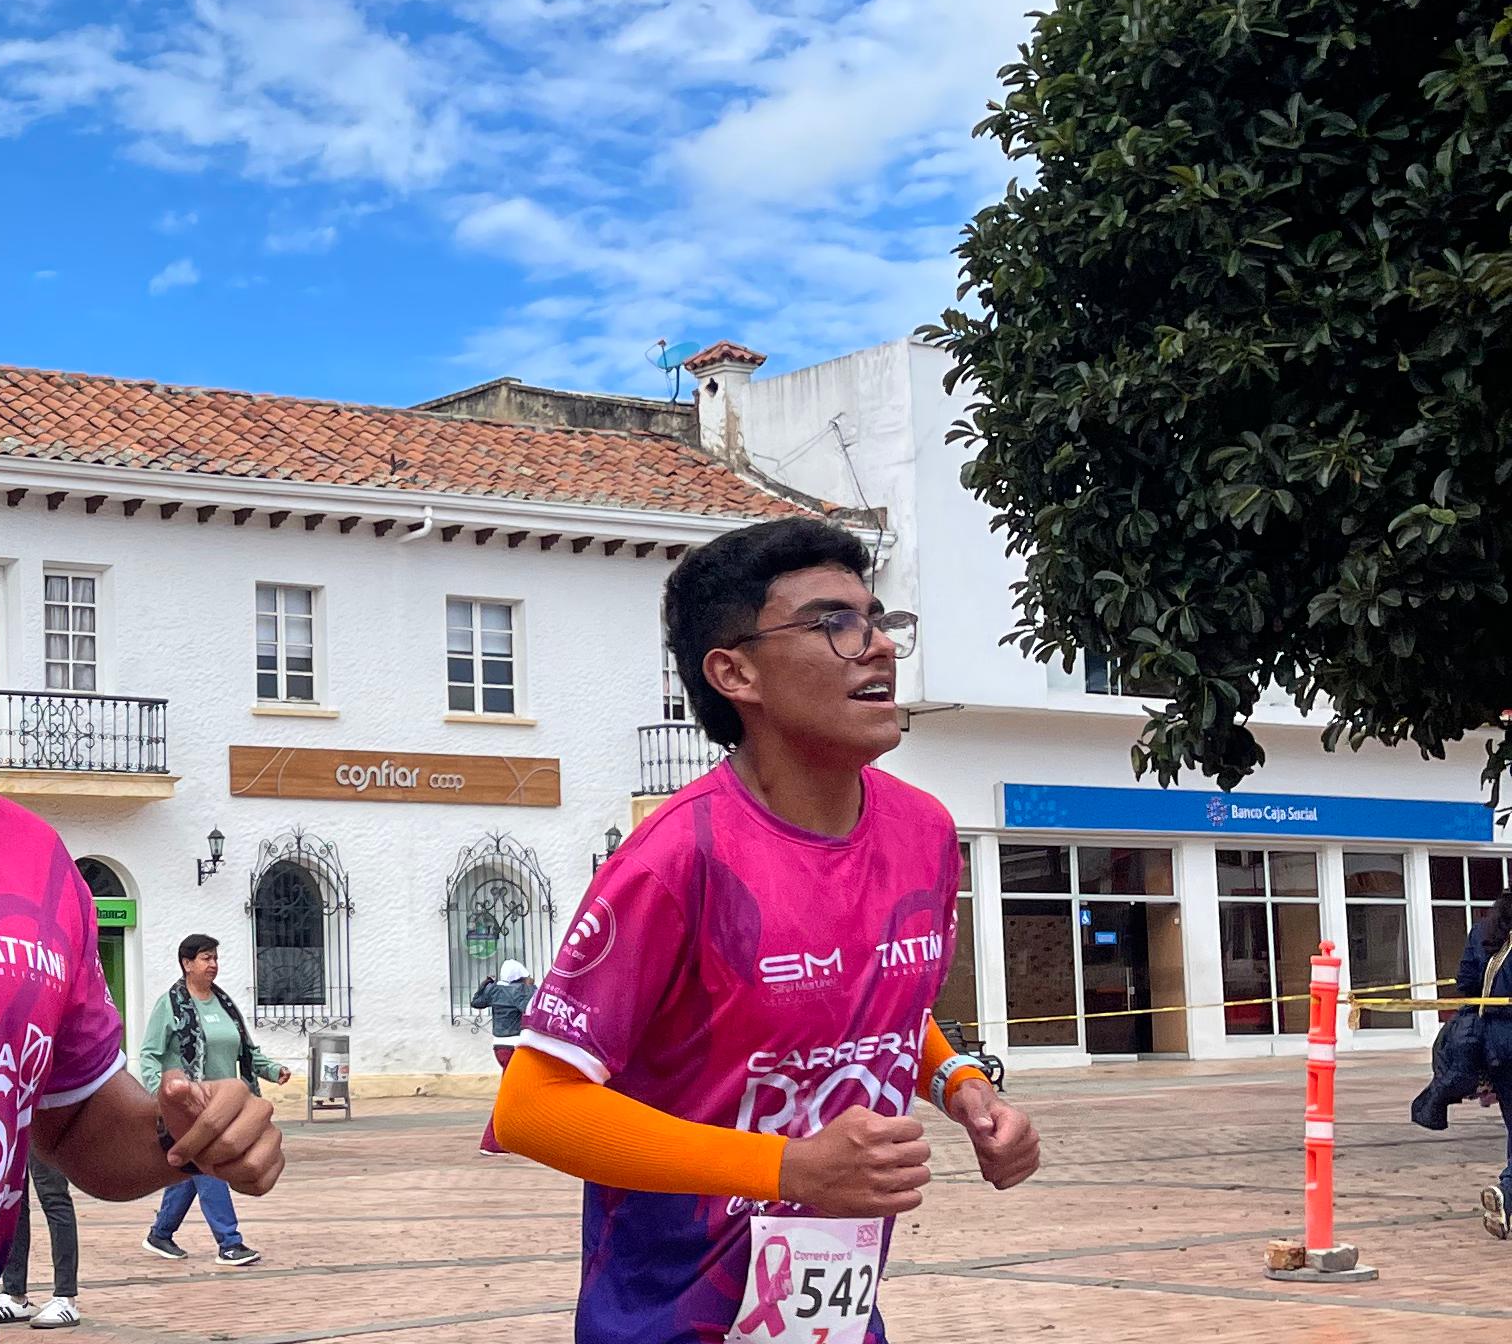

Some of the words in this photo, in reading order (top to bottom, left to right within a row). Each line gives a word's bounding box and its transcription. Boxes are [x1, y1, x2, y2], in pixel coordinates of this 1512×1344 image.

[336, 760, 420, 792] confiar
[429, 773, 465, 793] coop
[1231, 805, 1263, 820] Banco
[1264, 806, 1286, 823] Caja
[1288, 806, 1318, 822] Social
[759, 947, 843, 984] SM
[796, 1265, 874, 1318] 542
